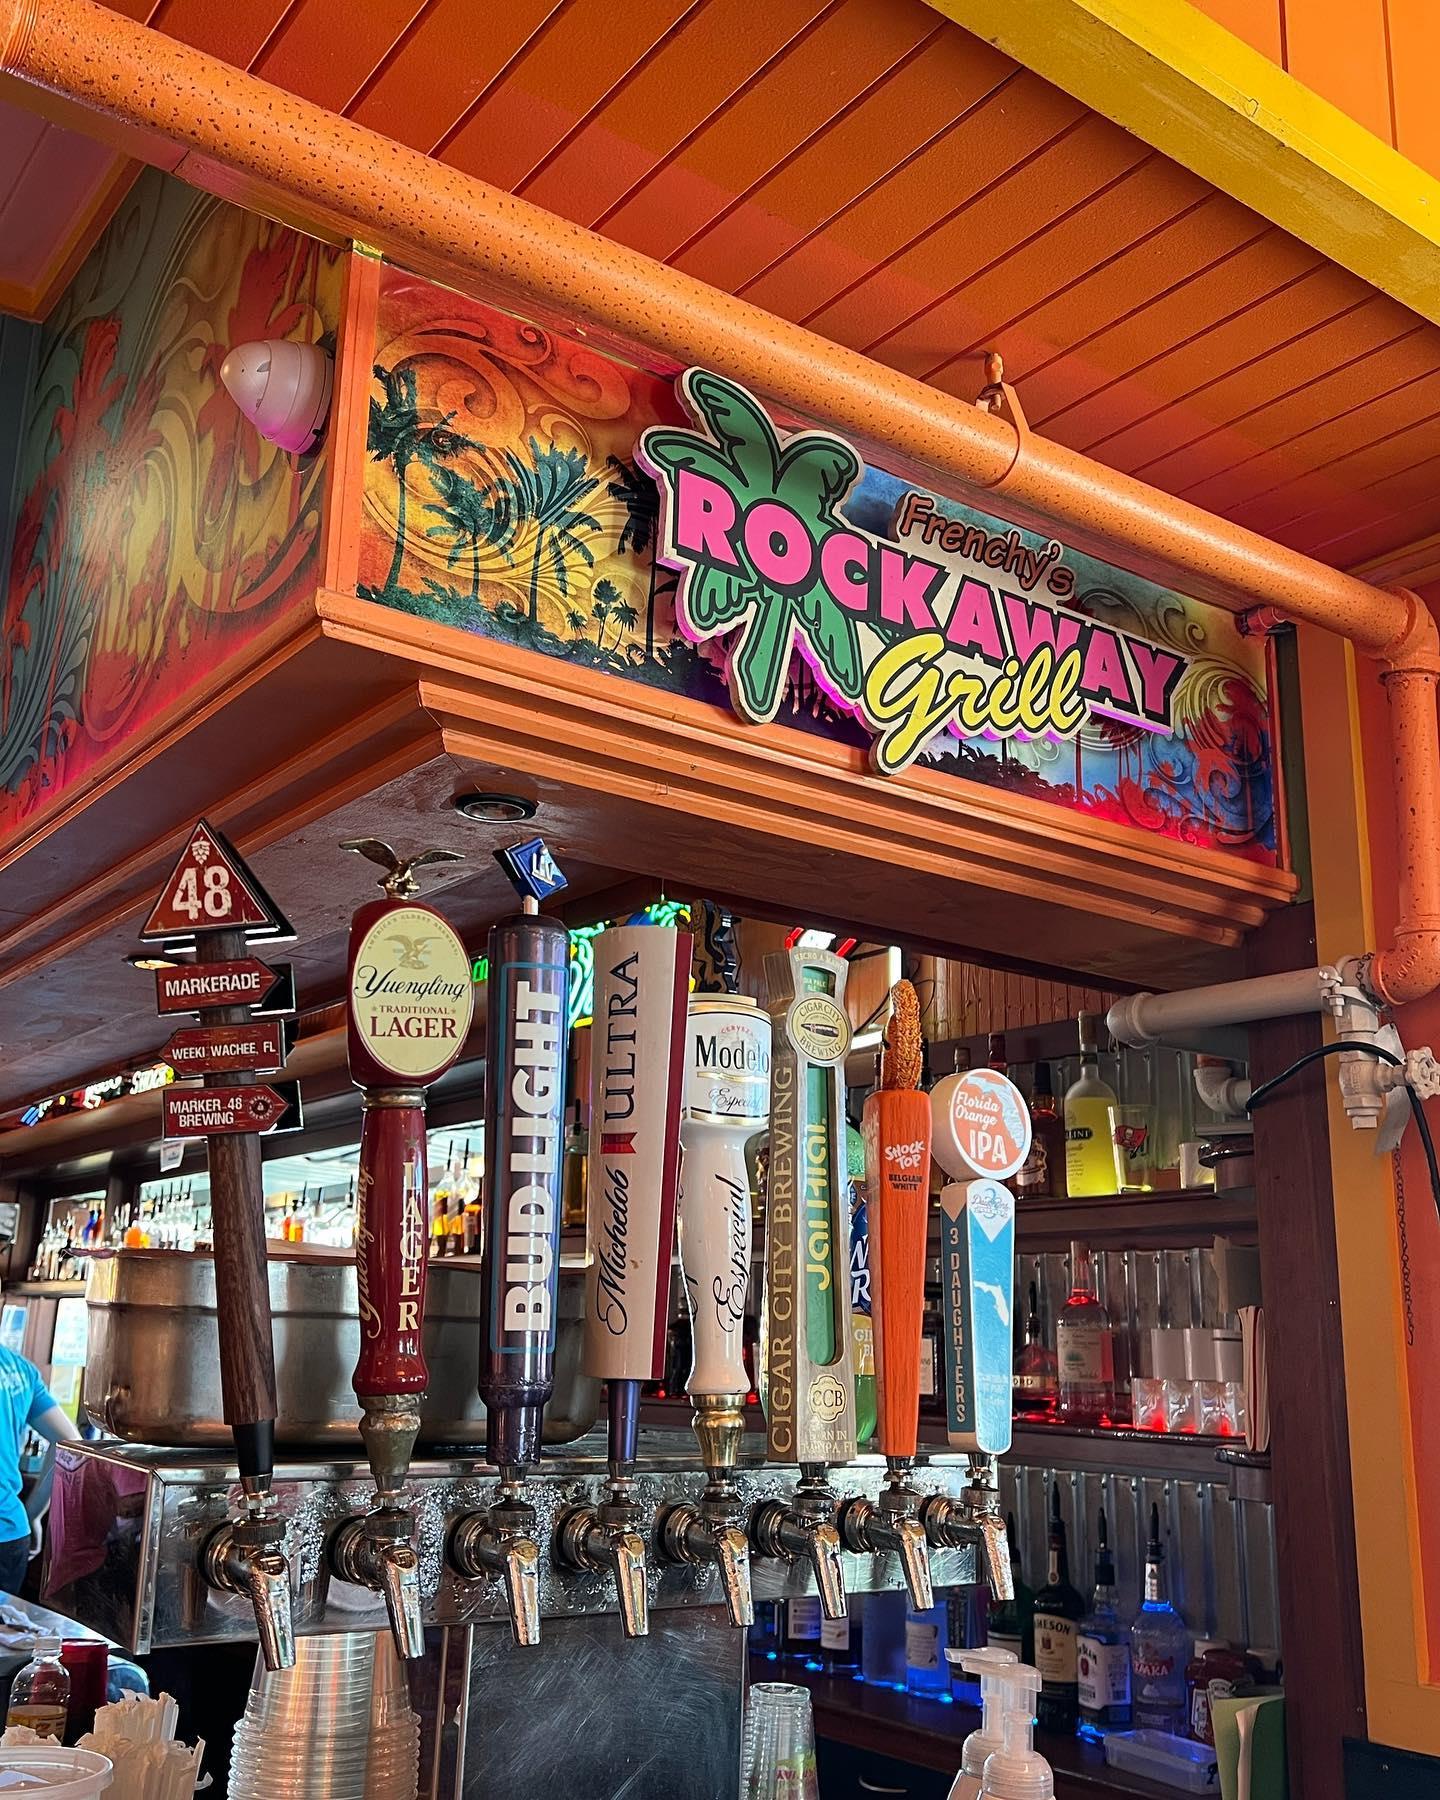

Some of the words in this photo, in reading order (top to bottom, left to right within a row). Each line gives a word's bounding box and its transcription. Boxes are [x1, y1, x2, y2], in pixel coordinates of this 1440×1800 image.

[900, 494, 1075, 597] Frenchy's
[678, 467, 1185, 716] ROCKAWAY
[866, 632, 1084, 771] Grill
[172, 865, 232, 920] 48
[165, 973, 260, 997] MARKERADE
[354, 965, 469, 1002] Yuengling
[380, 1005, 450, 1015] TRADITIONAL
[799, 1002, 824, 1017] CIGAR
[824, 1005, 841, 1022] CITY
[370, 1016, 458, 1038] LAGER
[604, 951, 640, 1124] ULTRA
[721, 1023, 755, 1037] CERVEZ
[172, 1048, 205, 1060] WEEKI
[263, 1041, 276, 1053] FL
[695, 1034, 769, 1074] Modelo
[801, 1036, 841, 1057] BREWING
[170, 1099, 221, 1114] MARKER
[227, 1097, 243, 1110] 48
[956, 1091, 1000, 1113] Florida
[179, 1112, 234, 1127] BREWING
[955, 1104, 998, 1130] Orange
[773, 1065, 794, 1223] BREWING
[884, 1141, 926, 1161] SHOCK
[969, 1129, 1008, 1165] IPA
[895, 1154, 921, 1169] TOP
[888, 1174, 923, 1183] BELGIAN
[891, 1183, 919, 1192] WHITE
[396, 1162, 424, 1332] LAGER
[950, 1227, 958, 1245] 3
[597, 1164, 629, 1336] Michelob
[712, 1173, 747, 1334] Especial
[772, 1237, 792, 1321] CITY
[950, 1252, 966, 1423] DAUGHTERS
[771, 1334, 792, 1454] CIGAR
[812, 1389, 843, 1408] CCB
[837, 1430, 847, 1440] IN
